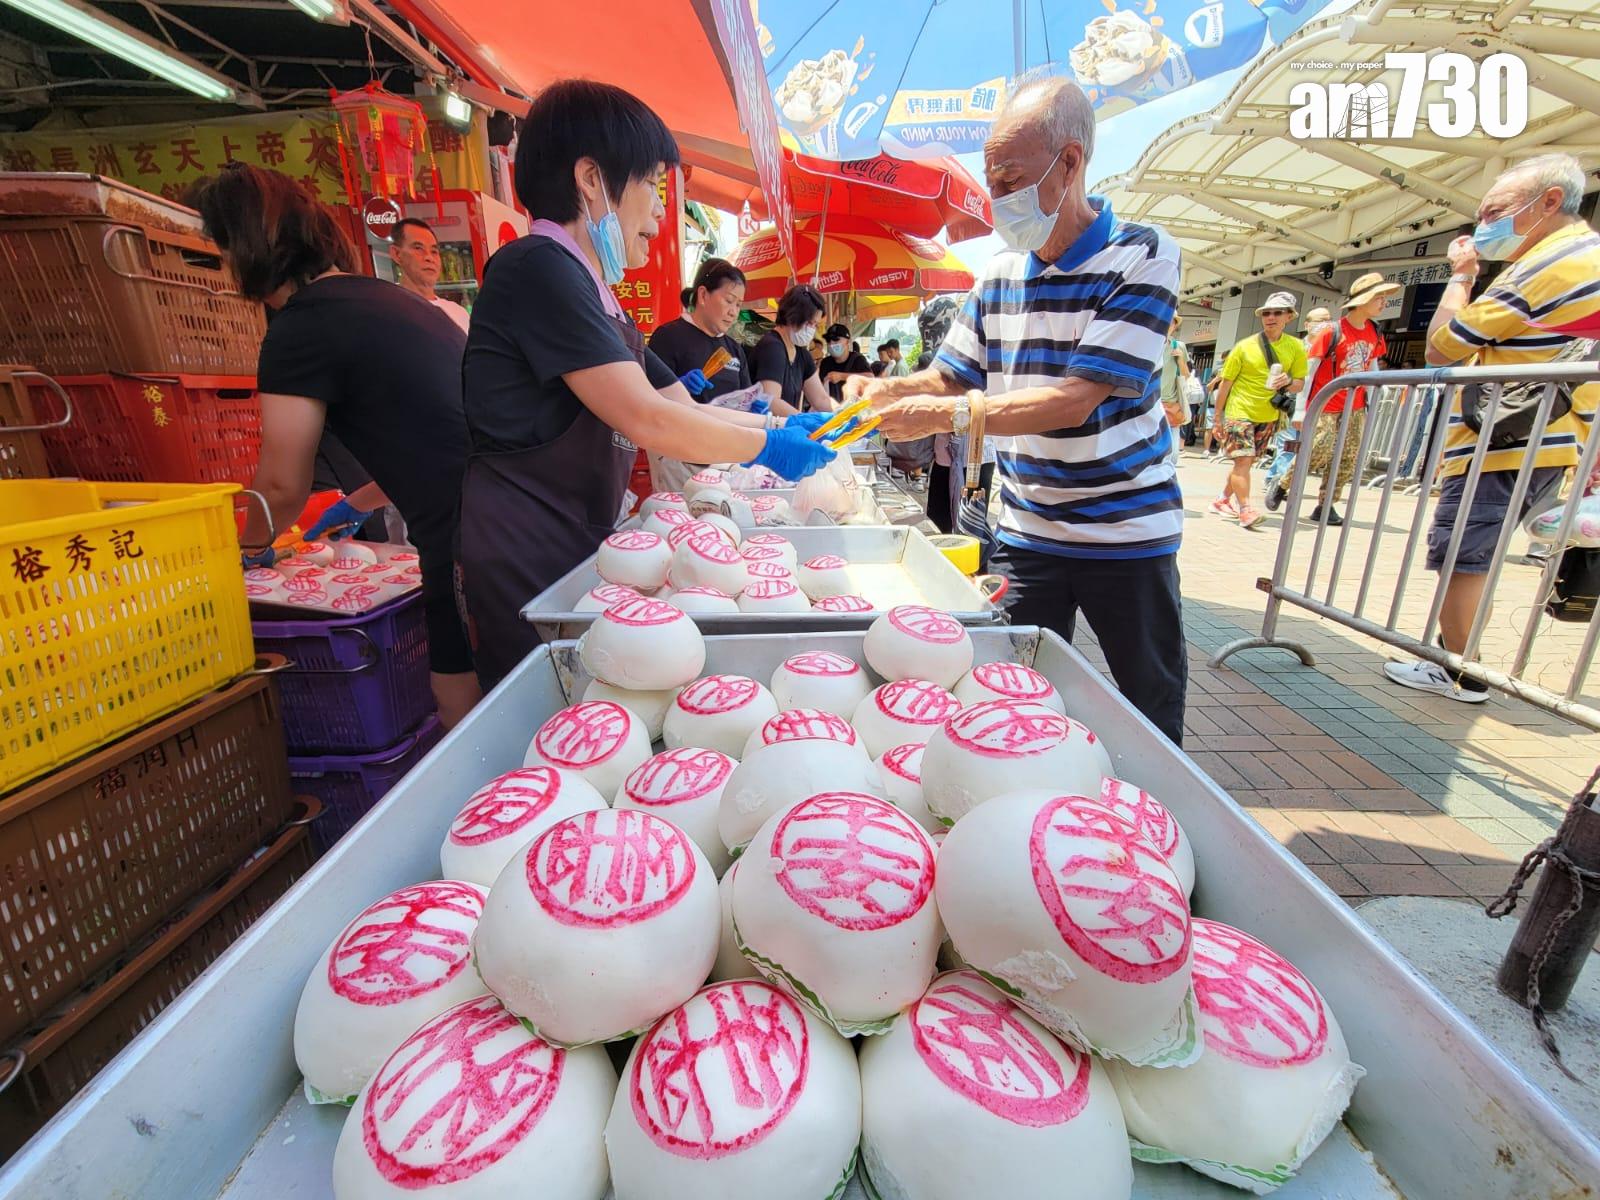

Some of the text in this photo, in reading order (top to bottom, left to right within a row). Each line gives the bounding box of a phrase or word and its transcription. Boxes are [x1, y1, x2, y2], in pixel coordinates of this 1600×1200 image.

[366, 211, 398, 225] Coca-Cola
[868, 270, 909, 287] vitasoy
[11, 529, 144, 583] 榕秀記
